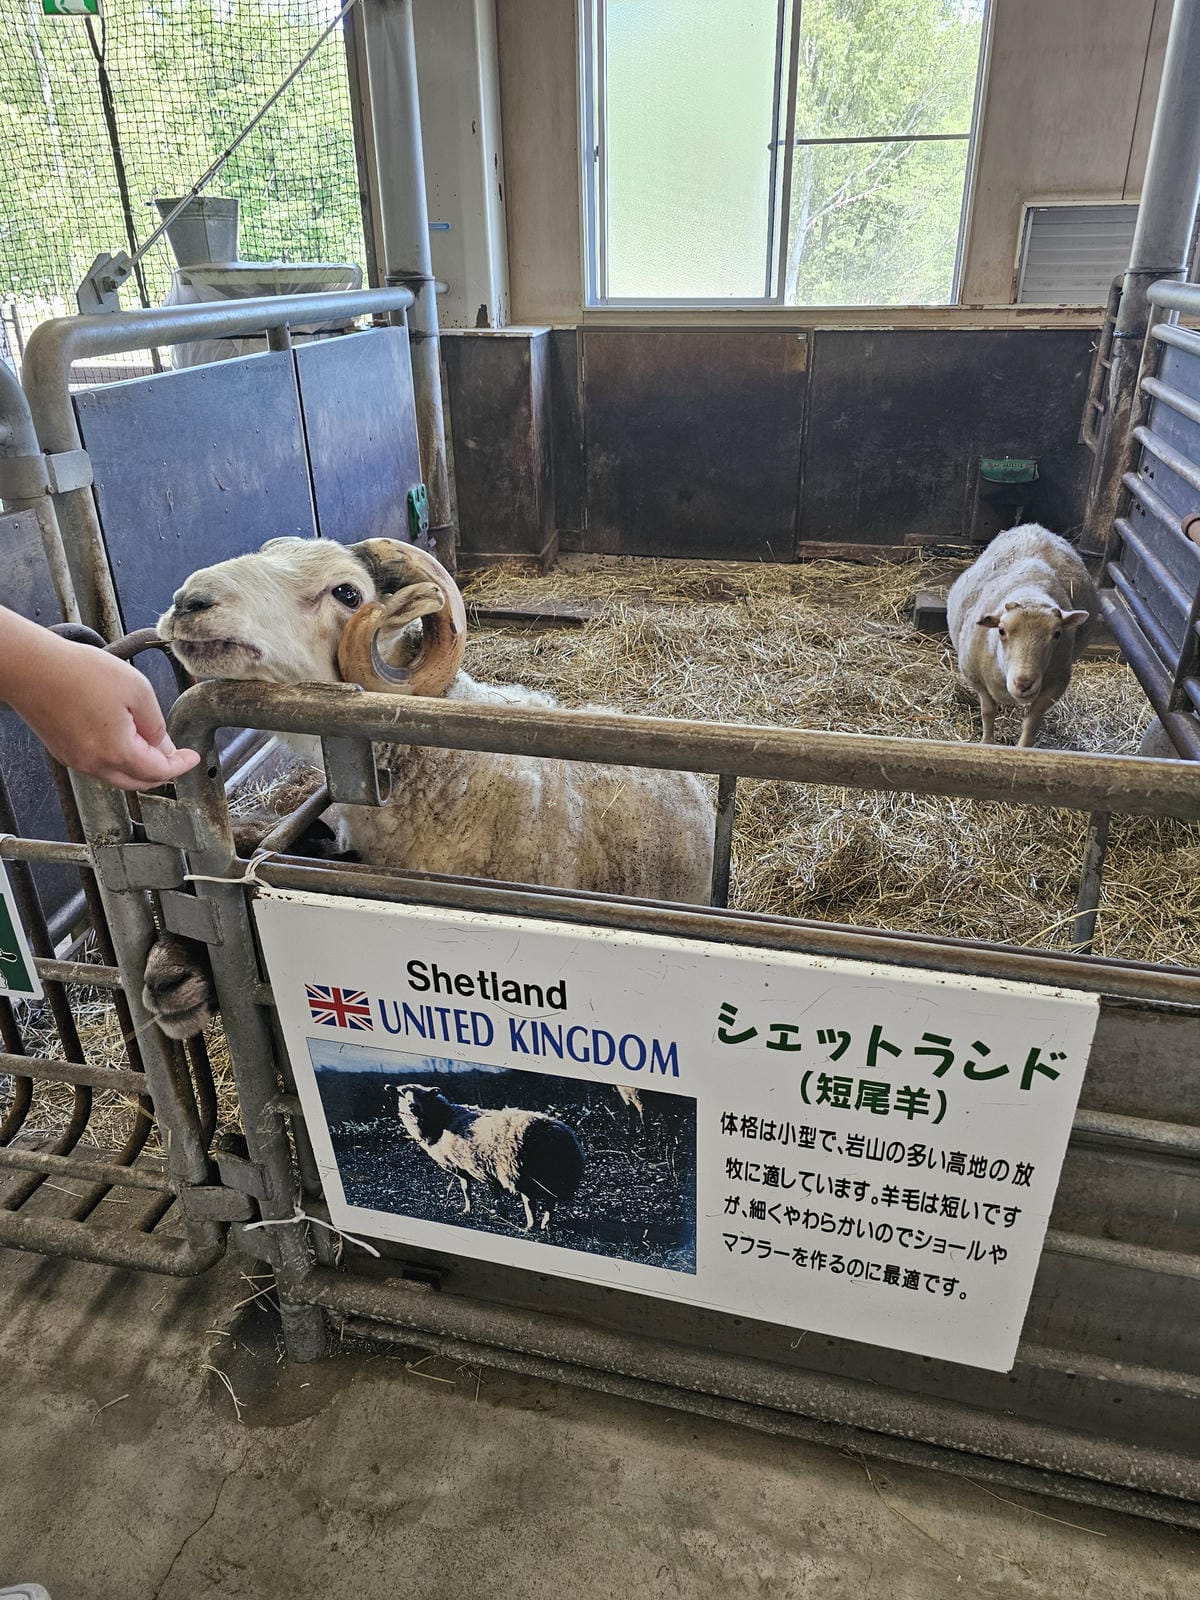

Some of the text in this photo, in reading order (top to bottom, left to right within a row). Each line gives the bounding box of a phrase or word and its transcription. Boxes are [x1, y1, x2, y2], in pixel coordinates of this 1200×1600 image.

[406, 959, 568, 1011] Shetland
[379, 998, 680, 1078] UNITED KINGDOM
[716, 1001, 1068, 1091] シェットランド
[800, 1069, 948, 1125] (短尾羊)
[719, 1111, 1036, 1188] 体格は小型で、岩山の多い高地の放
[725, 1156, 1023, 1229] 牧に適しています。羊毛は短いです
[722, 1195, 1008, 1265] が、細くやわらかいのでショールや
[722, 1232, 967, 1301] マフラーを作るのに最適です。
